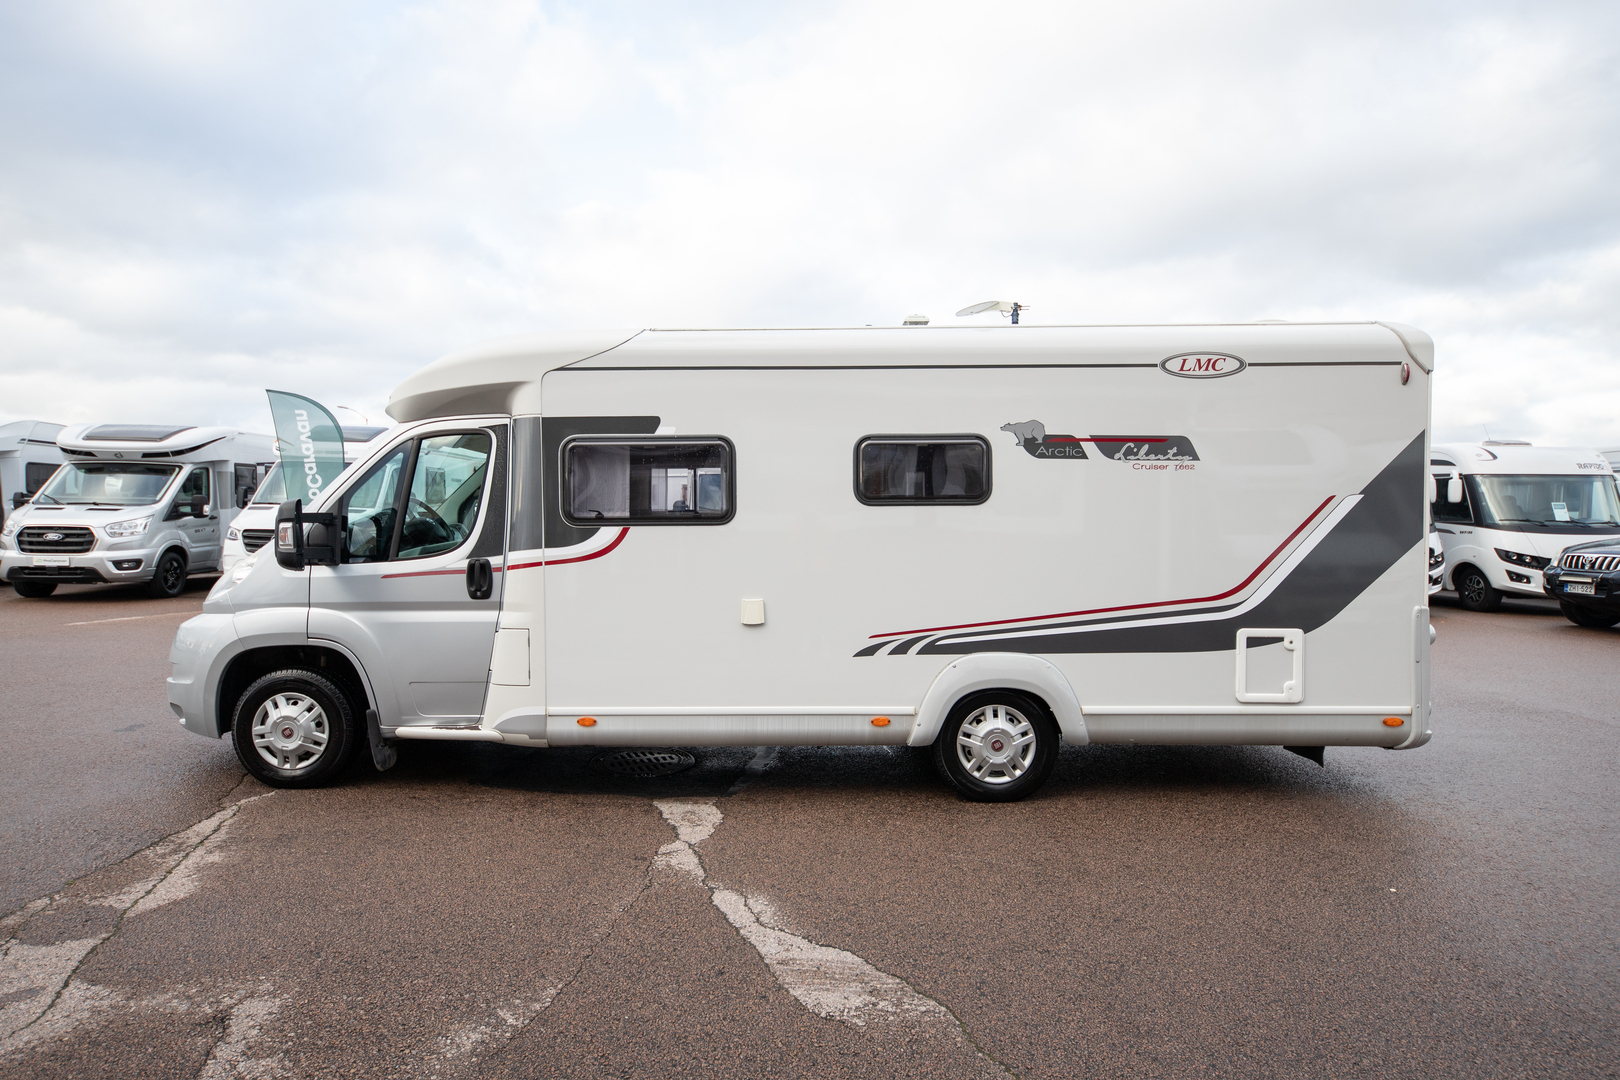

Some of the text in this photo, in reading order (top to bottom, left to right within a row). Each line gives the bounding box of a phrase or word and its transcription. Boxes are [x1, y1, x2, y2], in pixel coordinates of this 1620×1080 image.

[1178, 358, 1226, 372] LMC
[1035, 446, 1083, 457] Arctic
[1113, 442, 1193, 471] Liberty
